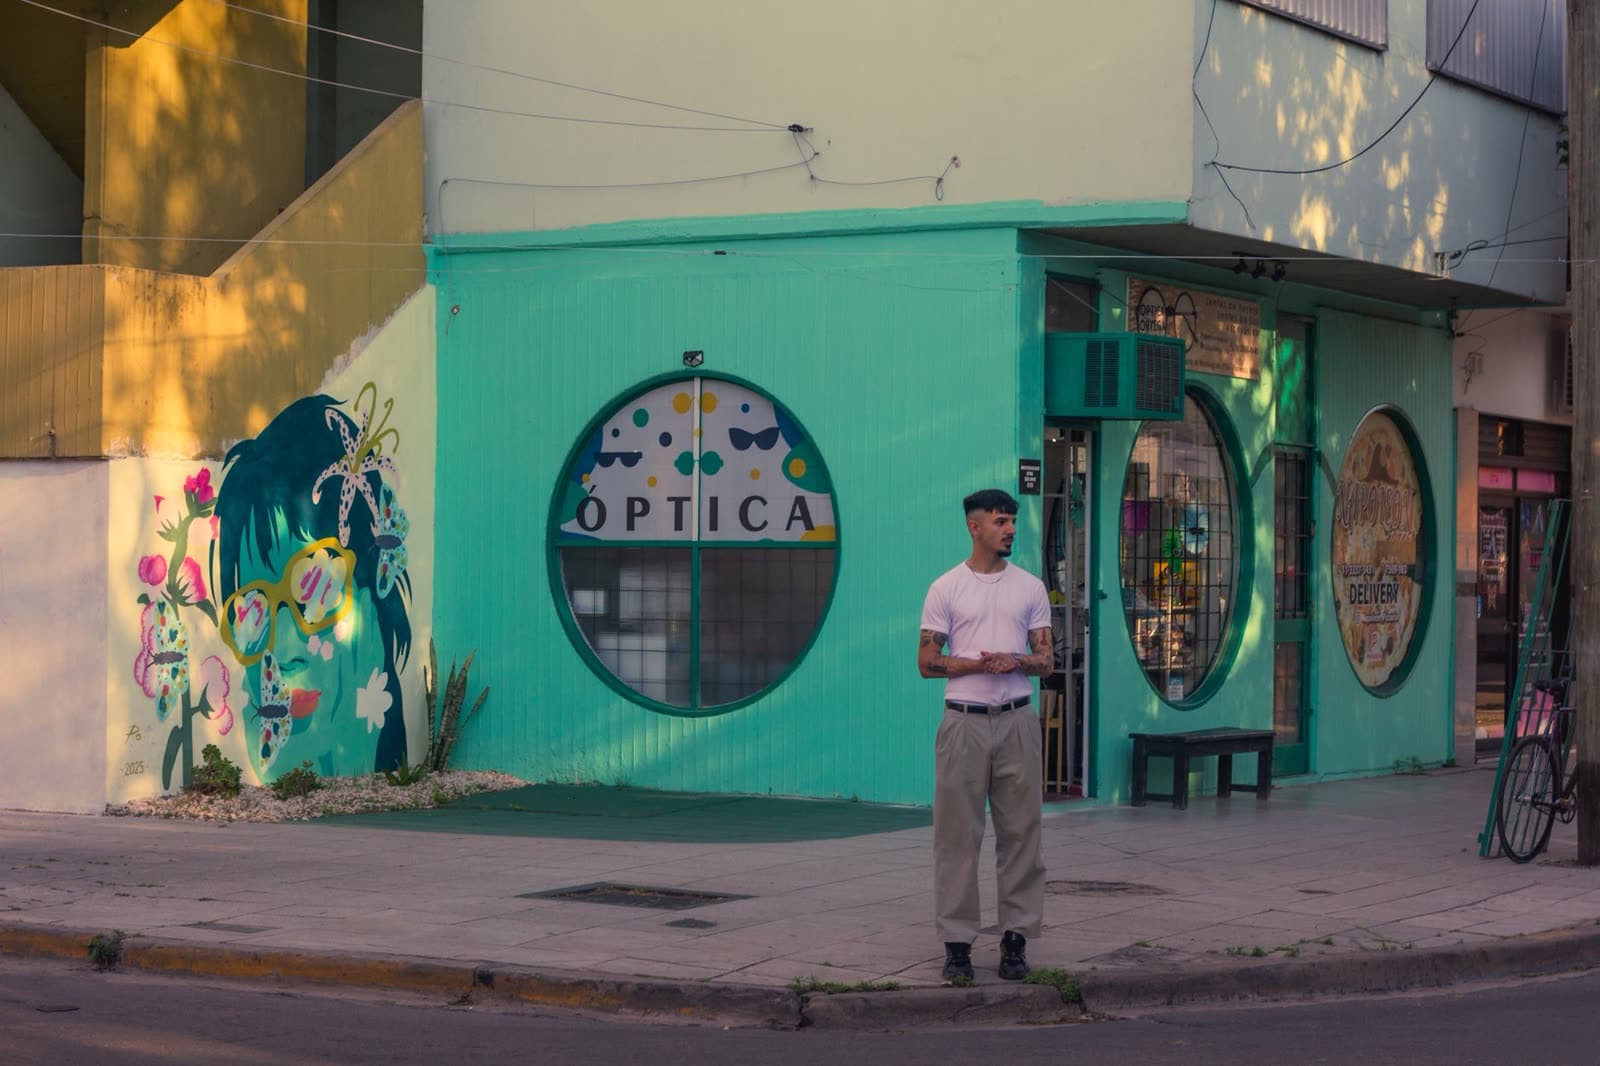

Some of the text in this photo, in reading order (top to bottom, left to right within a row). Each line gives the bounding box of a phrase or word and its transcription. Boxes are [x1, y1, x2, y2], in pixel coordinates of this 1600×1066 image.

[576, 485, 815, 532] ÓPTICA
[1349, 583, 1399, 605] DELIVERY
[124, 761, 144, 776] 2025
